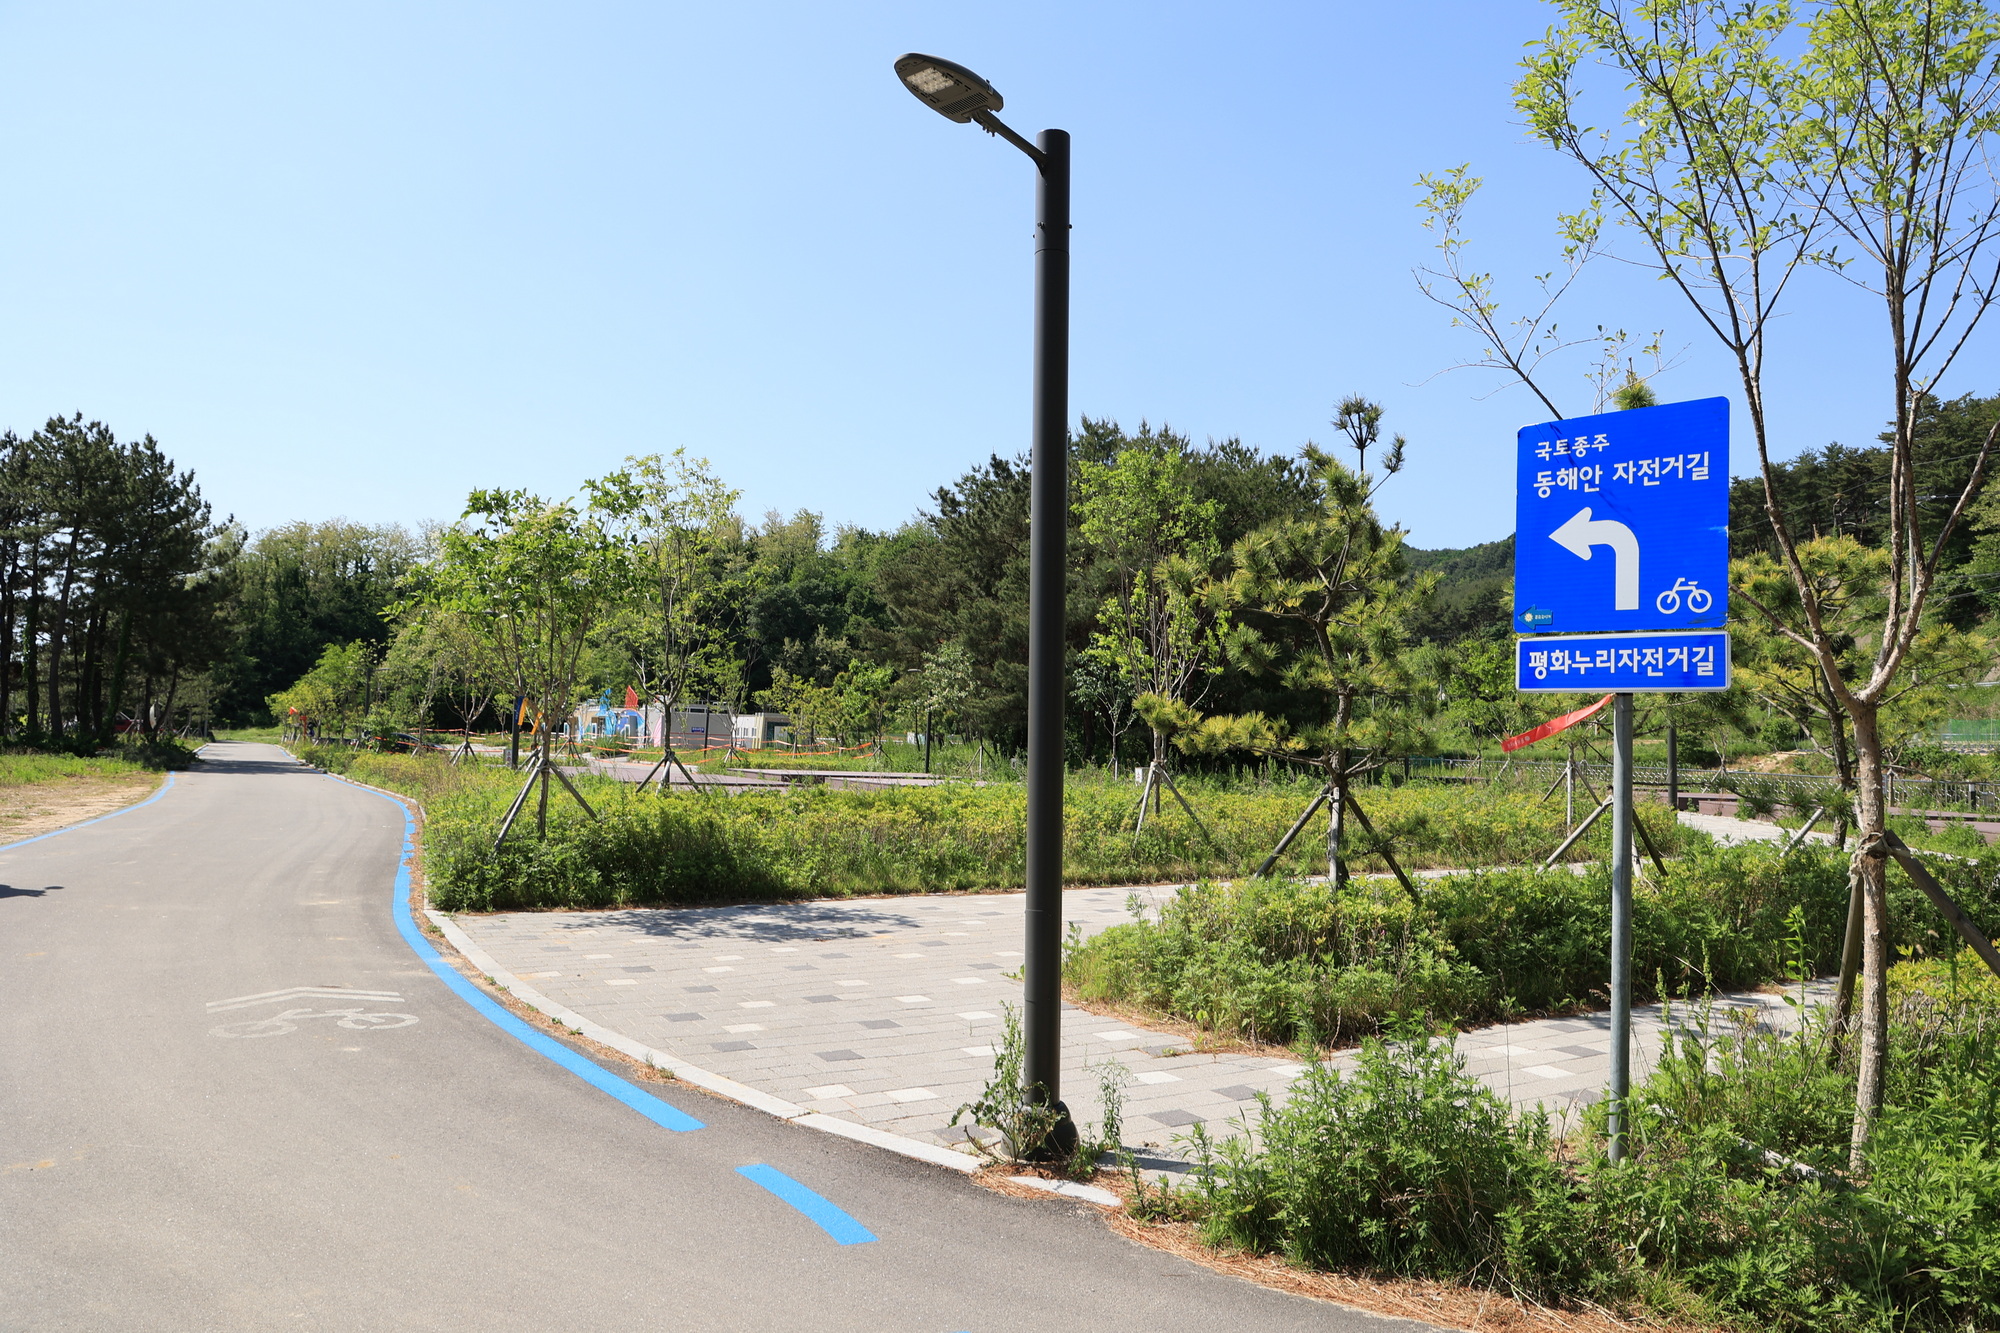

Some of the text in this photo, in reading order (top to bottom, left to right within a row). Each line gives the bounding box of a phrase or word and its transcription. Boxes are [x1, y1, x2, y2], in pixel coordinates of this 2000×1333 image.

[1535, 434, 1610, 461] 국토종주
[1533, 452, 1709, 499] 동해안 자전거길
[1528, 646, 1714, 680] 평화누리자전거길
